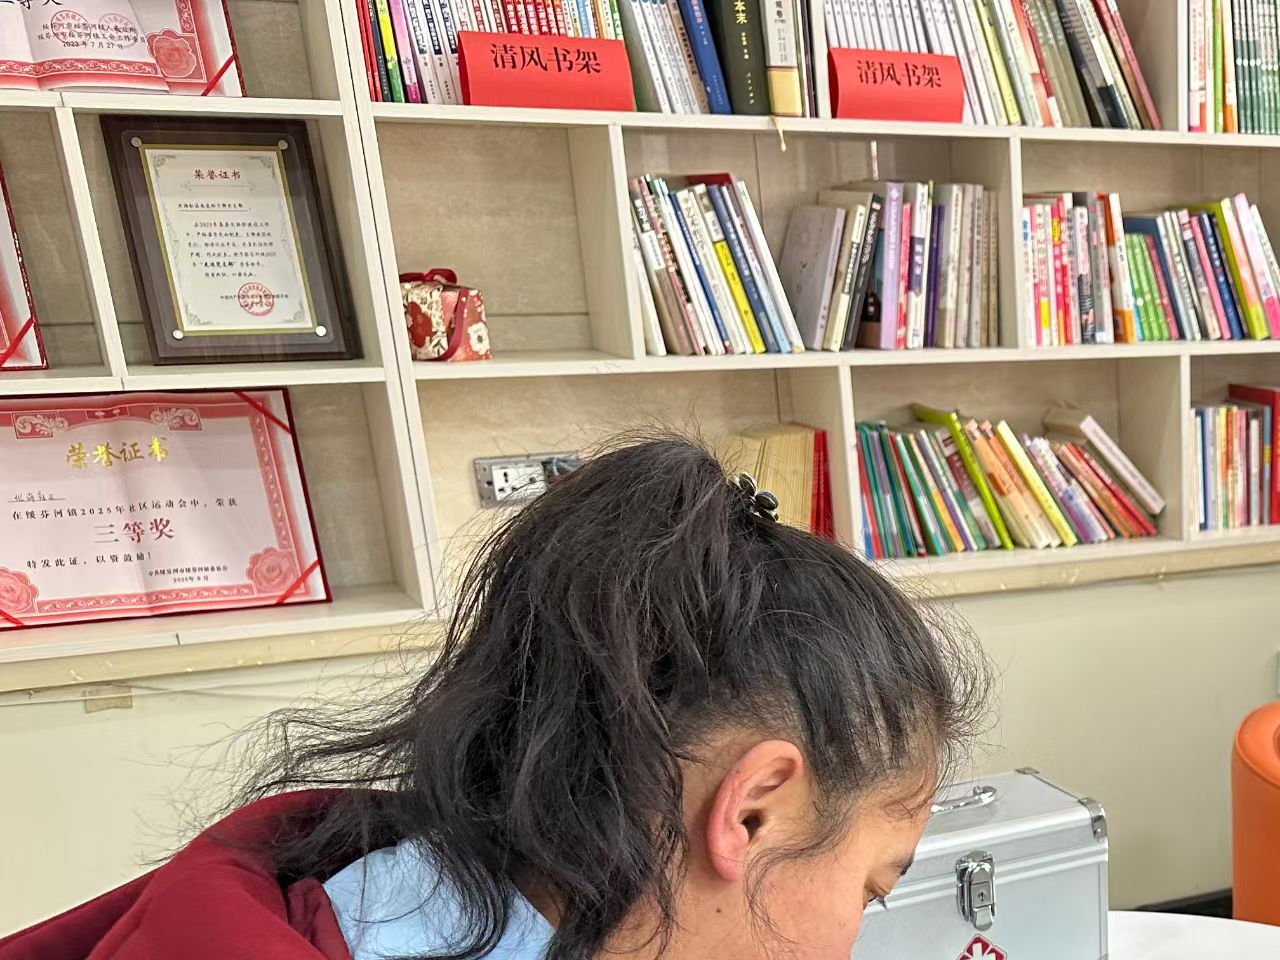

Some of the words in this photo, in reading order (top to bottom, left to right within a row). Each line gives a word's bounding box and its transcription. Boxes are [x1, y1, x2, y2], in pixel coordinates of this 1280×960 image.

[491, 43, 601, 74] 清风书架
[857, 60, 943, 89] 清风书架
[193, 169, 241, 181] 荣誉证书
[67, 437, 169, 468] 荣誉证书
[93, 517, 175, 544] 三等奖
